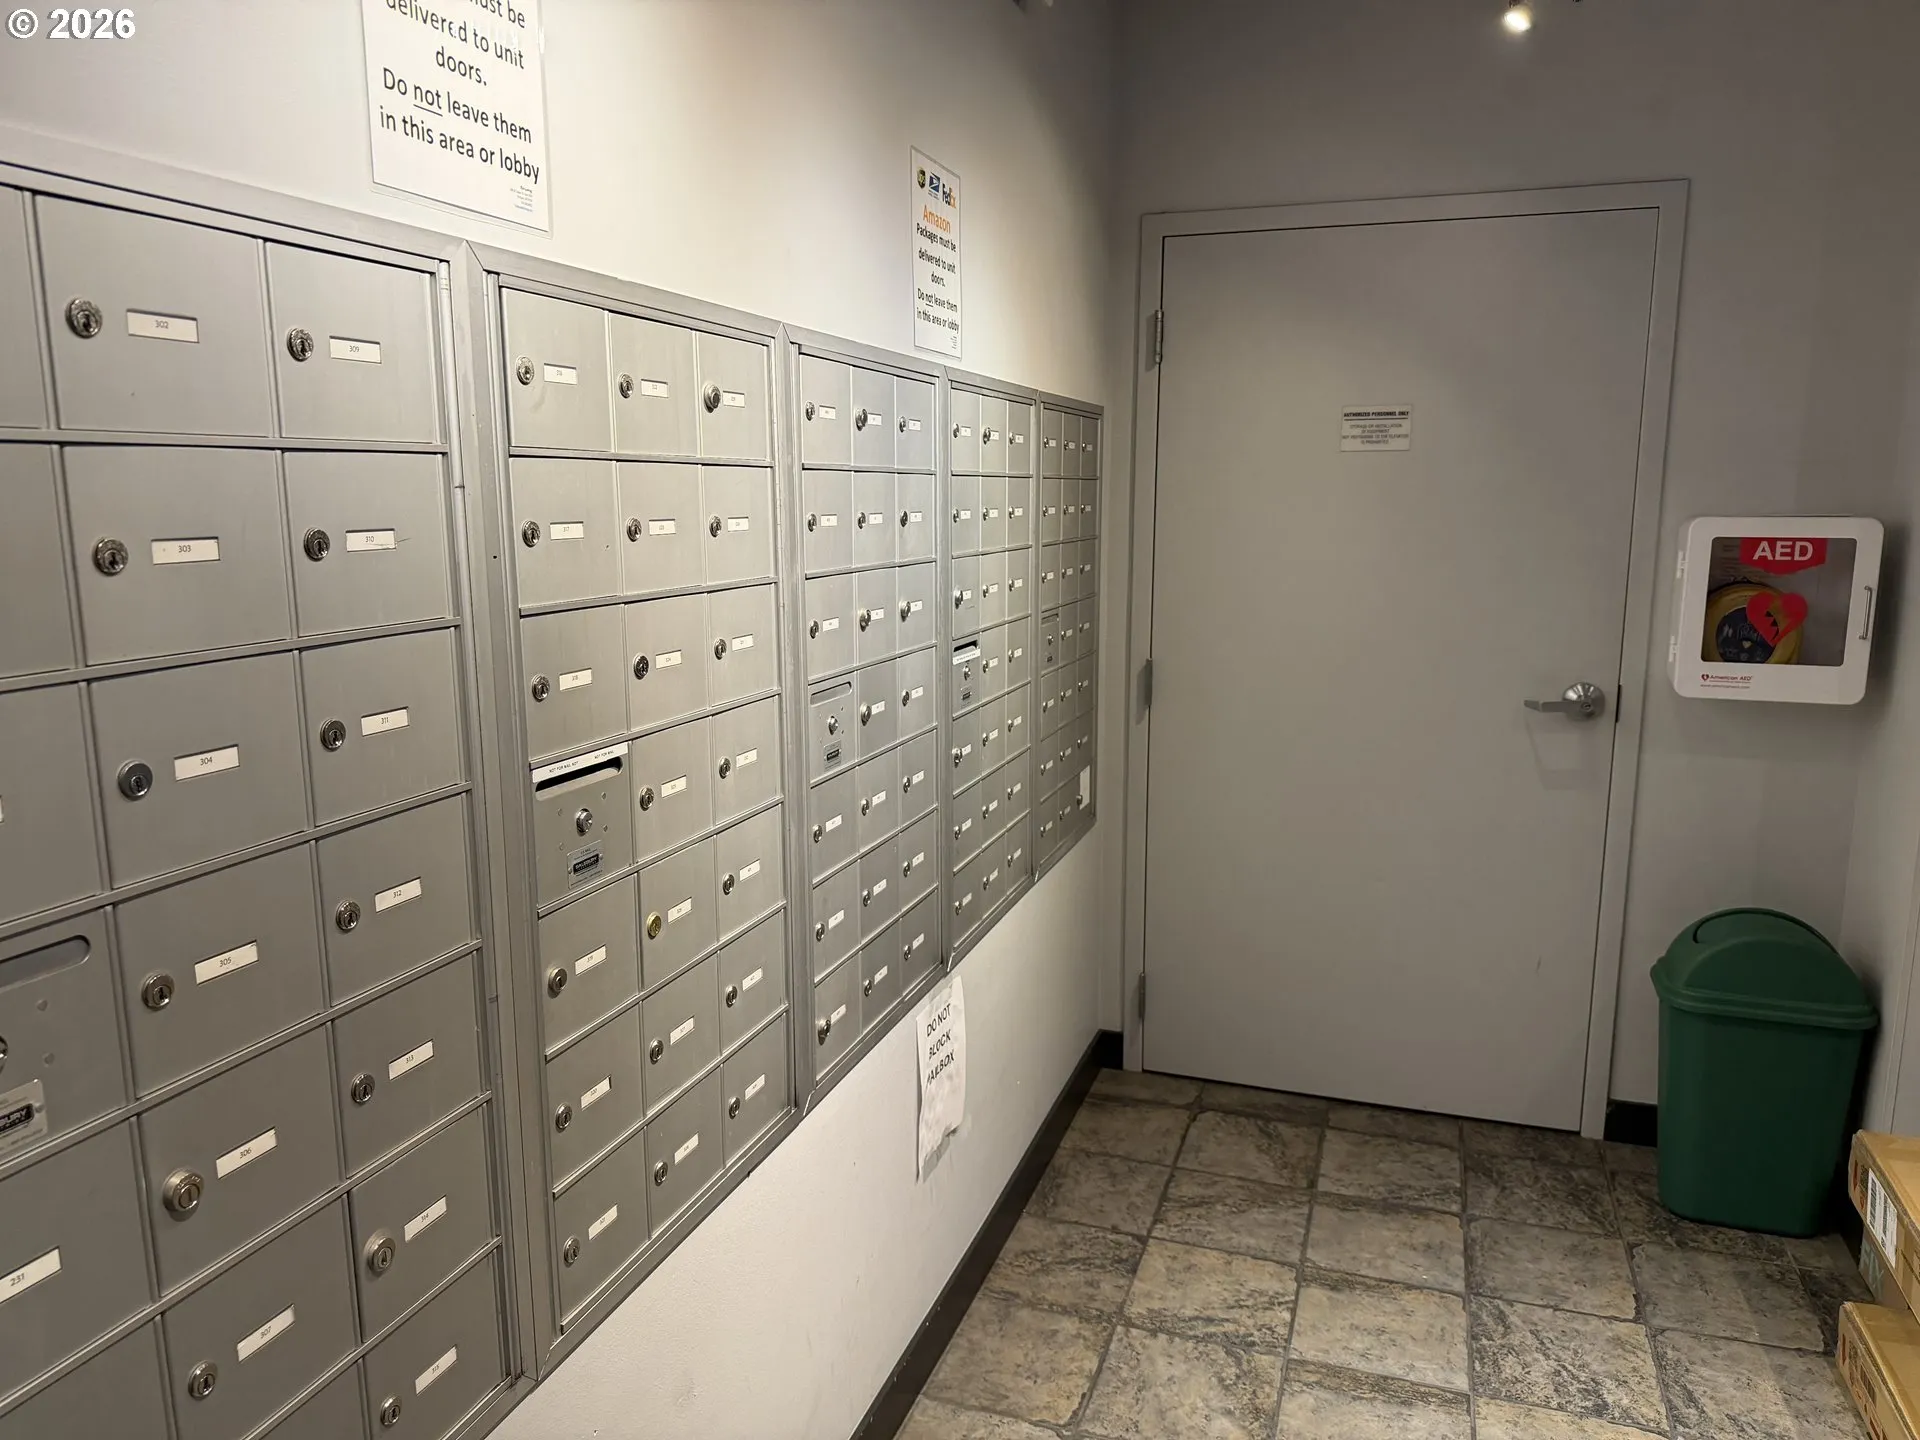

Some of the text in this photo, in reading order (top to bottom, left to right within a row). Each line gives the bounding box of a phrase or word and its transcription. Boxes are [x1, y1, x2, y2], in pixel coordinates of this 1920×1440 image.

[507, 0, 526, 28] be
[473, 28, 490, 53] to
[494, 41, 526, 69] unit
[435, 46, 488, 86] doors.
[383, 66, 533, 144] Do not leave them
[380, 105, 541, 184] in this area or lobby
[923, 203, 951, 234] Amazon
[916, 222, 938, 244] Packages
[917, 288, 924, 301] Do
[155, 319, 169, 330] 302
[349, 345, 360, 353] 309
[365, 535, 375, 543] 310
[178, 544, 192, 553] 303
[1752, 540, 1814, 561] AED
[200, 756, 213, 766] 304
[219, 956, 232, 968] 305
[927, 1003, 951, 1037] DO NOT
[239, 1147, 252, 1159] 306
[9, 1272, 26, 1287] 231
[259, 1326, 272, 1339] 307
